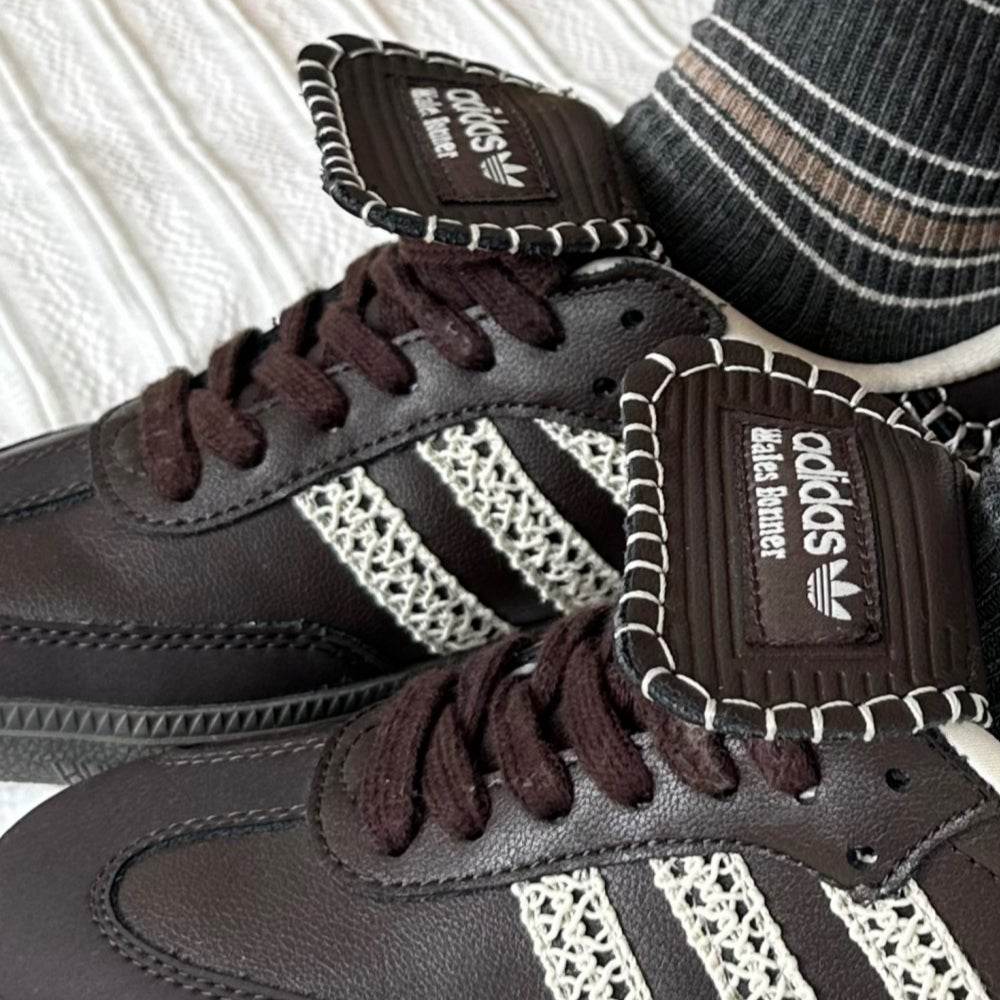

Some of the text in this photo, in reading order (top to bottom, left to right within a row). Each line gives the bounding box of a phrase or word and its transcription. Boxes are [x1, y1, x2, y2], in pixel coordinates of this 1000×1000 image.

[446, 88, 509, 152] adidas
[751, 427, 788, 559] Wales Bonner
[792, 431, 853, 555] adidas
